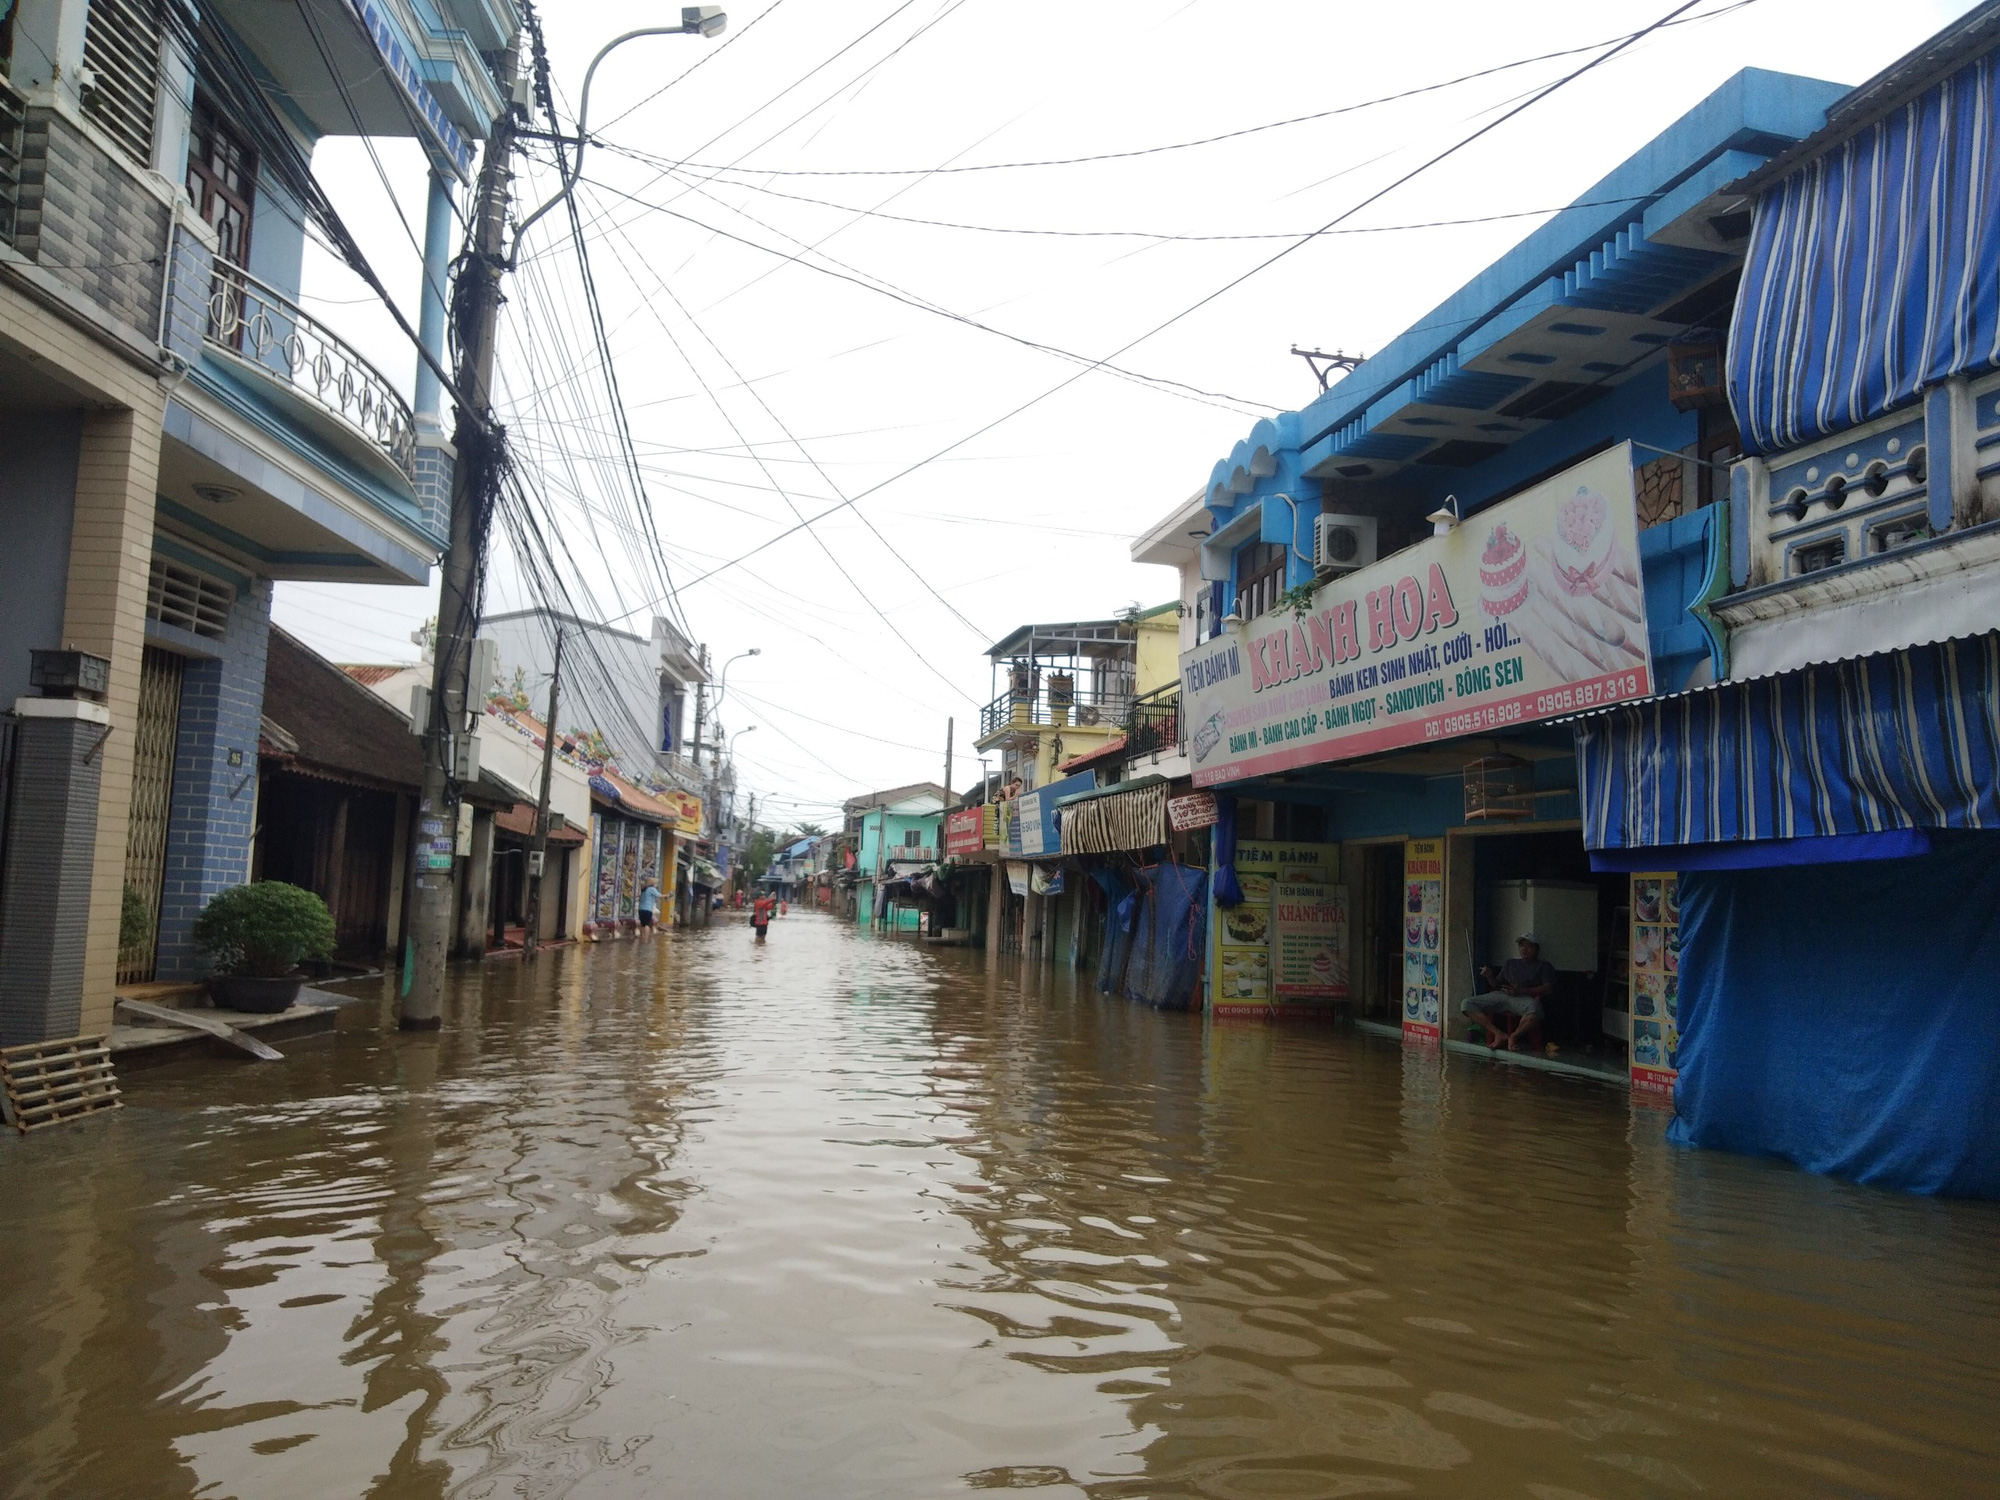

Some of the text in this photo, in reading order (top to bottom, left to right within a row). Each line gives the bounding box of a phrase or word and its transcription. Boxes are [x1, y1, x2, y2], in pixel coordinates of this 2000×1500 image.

[1247, 562, 1459, 693] KHÁNH HOA
[1185, 640, 1241, 697] TIỆM BÁNH MÌ
[1329, 672, 1355, 699] BÁNH
[1356, 665, 1379, 692] KEM
[1380, 656, 1406, 685] SINH
[1408, 643, 1441, 676] NHẬT,
[1443, 631, 1473, 666] CƯỚI
[1484, 616, 1521, 654] HỎI...
[1229, 732, 1247, 754] BÁNH
[1248, 727, 1258, 750] MÌ
[1263, 722, 1283, 746] BÁNH
[1284, 718, 1300, 741] CAO
[1301, 708, 1318, 736] CẤP
[1325, 704, 1350, 730] BÁNH
[1351, 697, 1376, 725] NGỌT
[1385, 679, 1445, 716] SANDWICH
[1455, 665, 1492, 698] BÔNG
[1495, 656, 1524, 688] SEN
[1444, 702, 1522, 733] 0905.516.902
[1537, 674, 1637, 714] 0905.887.313
[1237, 847, 1319, 864] TIỆM BÁNH
[1278, 901, 1346, 923] KHÁNH HOA
[1296, 886, 1315, 897] BÁNH
[1231, 1006, 1250, 1015] 0905
[1252, 1007, 1264, 1015] 516
